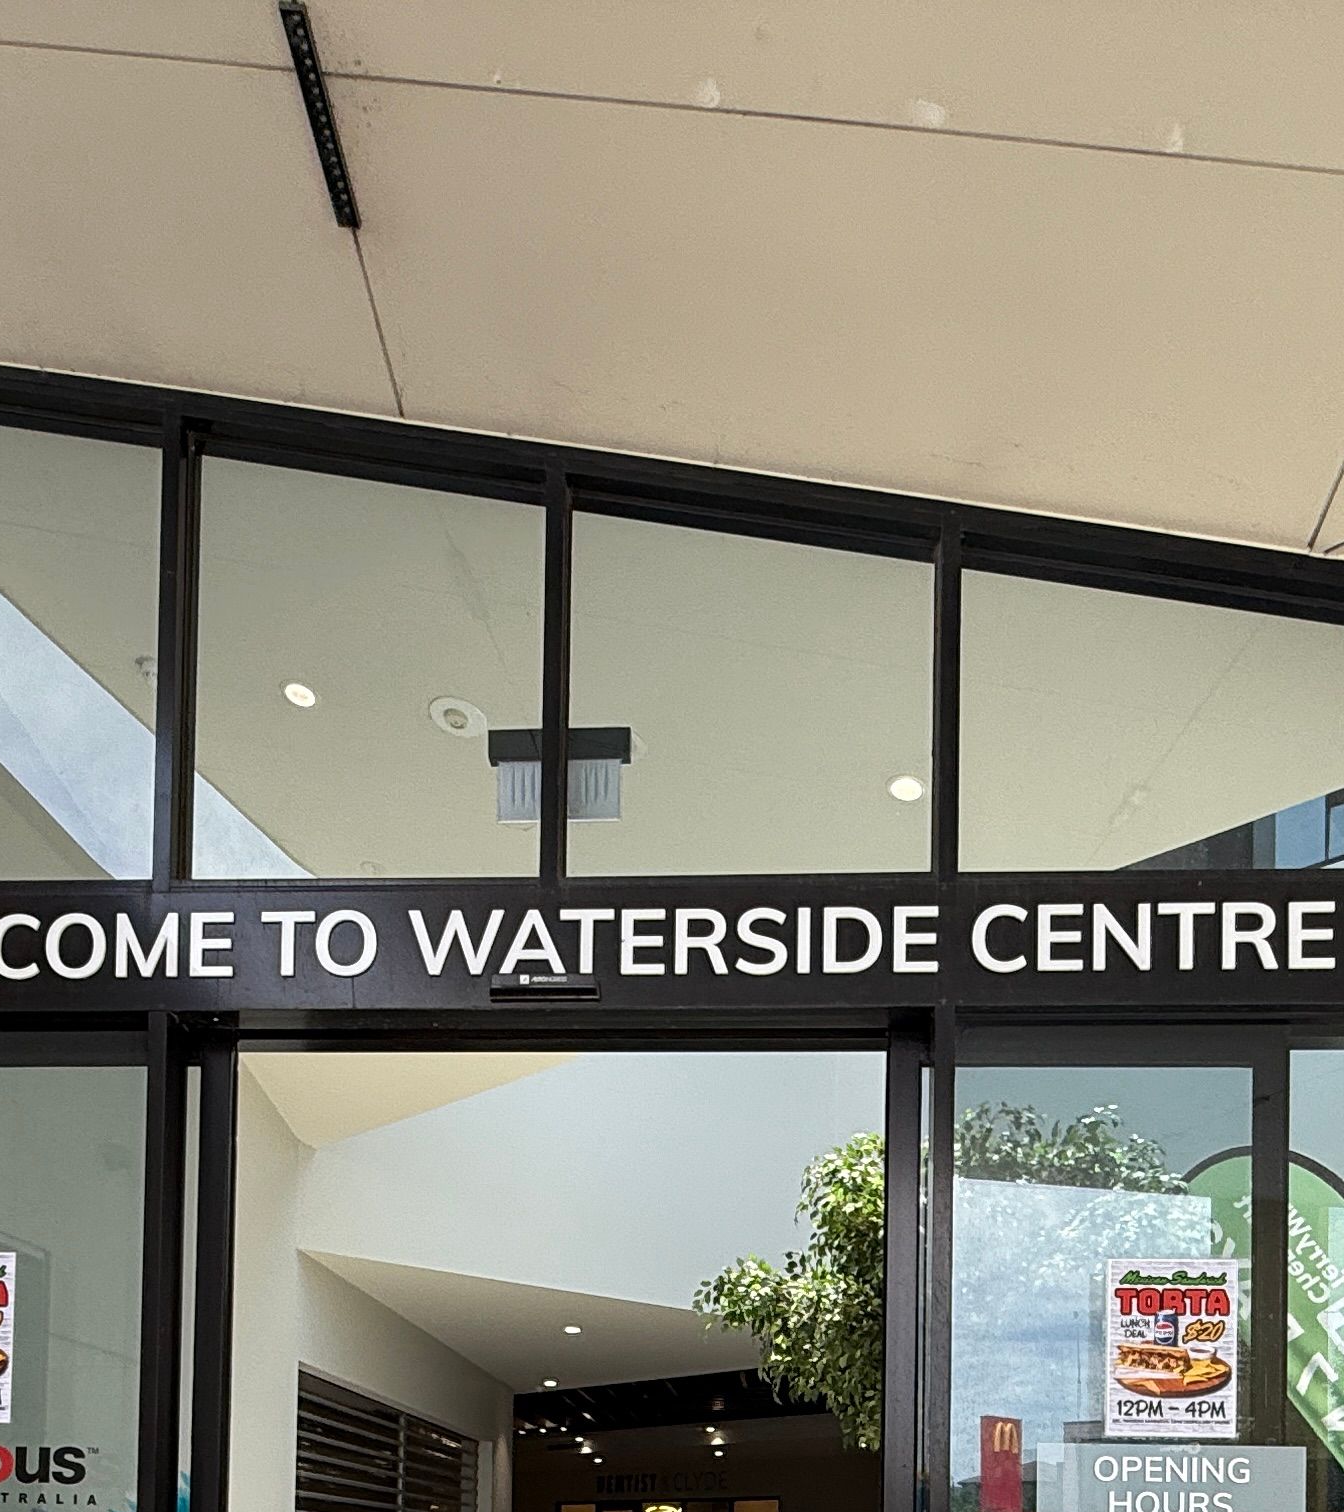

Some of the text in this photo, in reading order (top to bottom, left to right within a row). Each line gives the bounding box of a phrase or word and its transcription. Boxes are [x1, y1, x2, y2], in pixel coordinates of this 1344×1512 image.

[260, 908, 378, 977] TO
[408, 905, 940, 976] WATERSIDE
[971, 900, 1337, 974] CENTRE
[1115, 1288, 1230, 1316] TORTA
[1120, 1317, 1150, 1328] LUNCH
[1124, 1328, 1146, 1338] DEAL
[1182, 1319, 1225, 1344] $20
[1117, 1399, 1226, 1418] 12PM 4PM
[1094, 1456, 1250, 1484] OPENING
